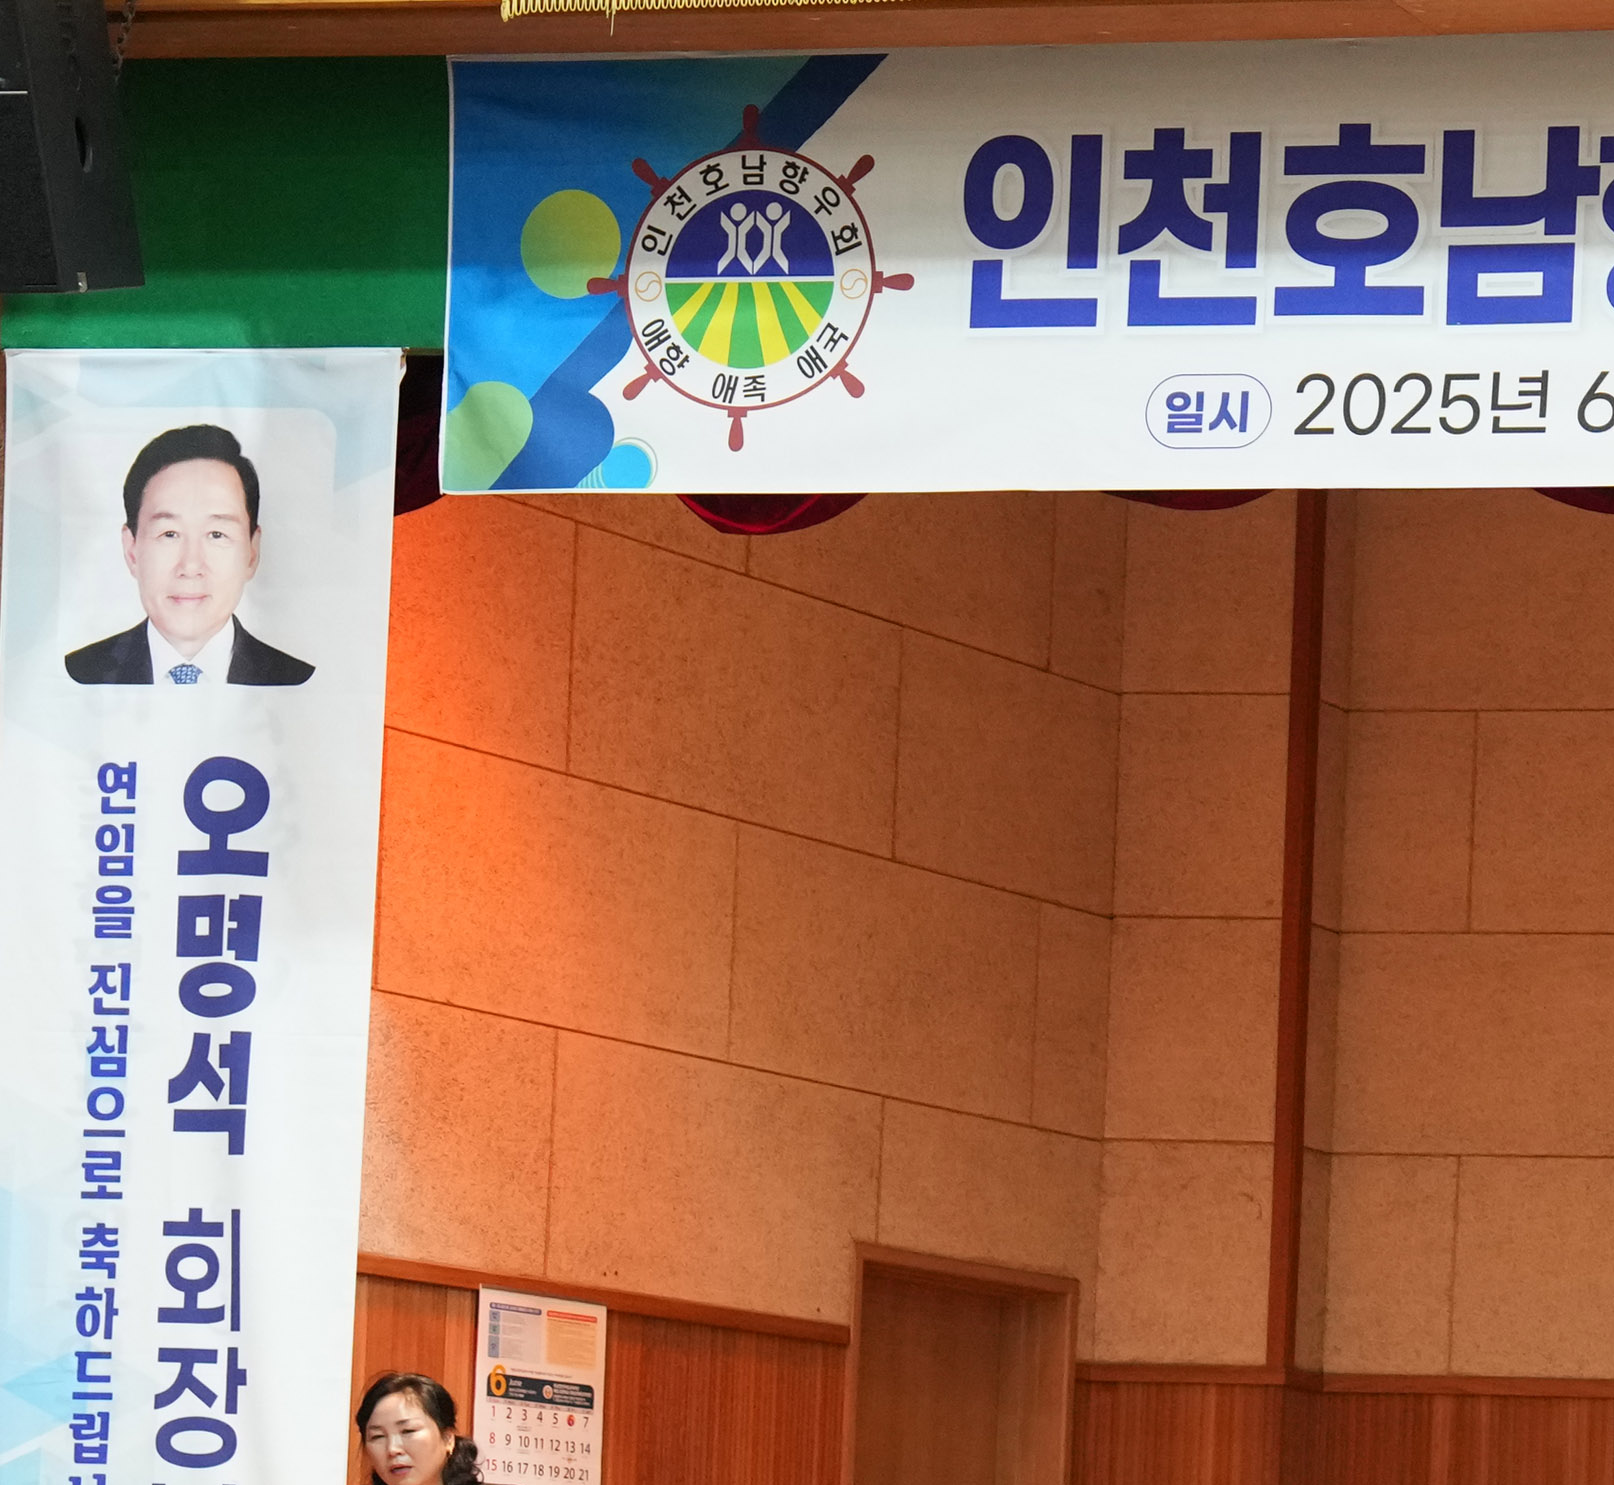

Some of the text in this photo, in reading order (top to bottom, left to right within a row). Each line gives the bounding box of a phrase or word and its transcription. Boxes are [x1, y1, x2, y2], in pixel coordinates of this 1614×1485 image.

[641, 153, 862, 257] 인천호남향우회
[641, 318, 849, 403] 애향 애족 애국
[1164, 391, 1252, 433] 일시
[1294, 368, 1549, 437] 2025년
[92, 761, 137, 939] 연임을
[167, 756, 271, 1155] 오명석
[80, 962, 131, 1200] 진심으로
[490, 1364, 506, 1396] 6
[492, 1405, 496, 1417] 1
[506, 1407, 512, 1420] 2
[522, 1409, 528, 1421] 3
[537, 1411, 542, 1423] 4
[552, 1413, 558, 1424] 5
[583, 1416, 589, 1428] 7
[486, 1459, 589, 1481] 15 16 17 18 19 20 21
[489, 1432, 591, 1454] 8 9 10 11 12 13 14
